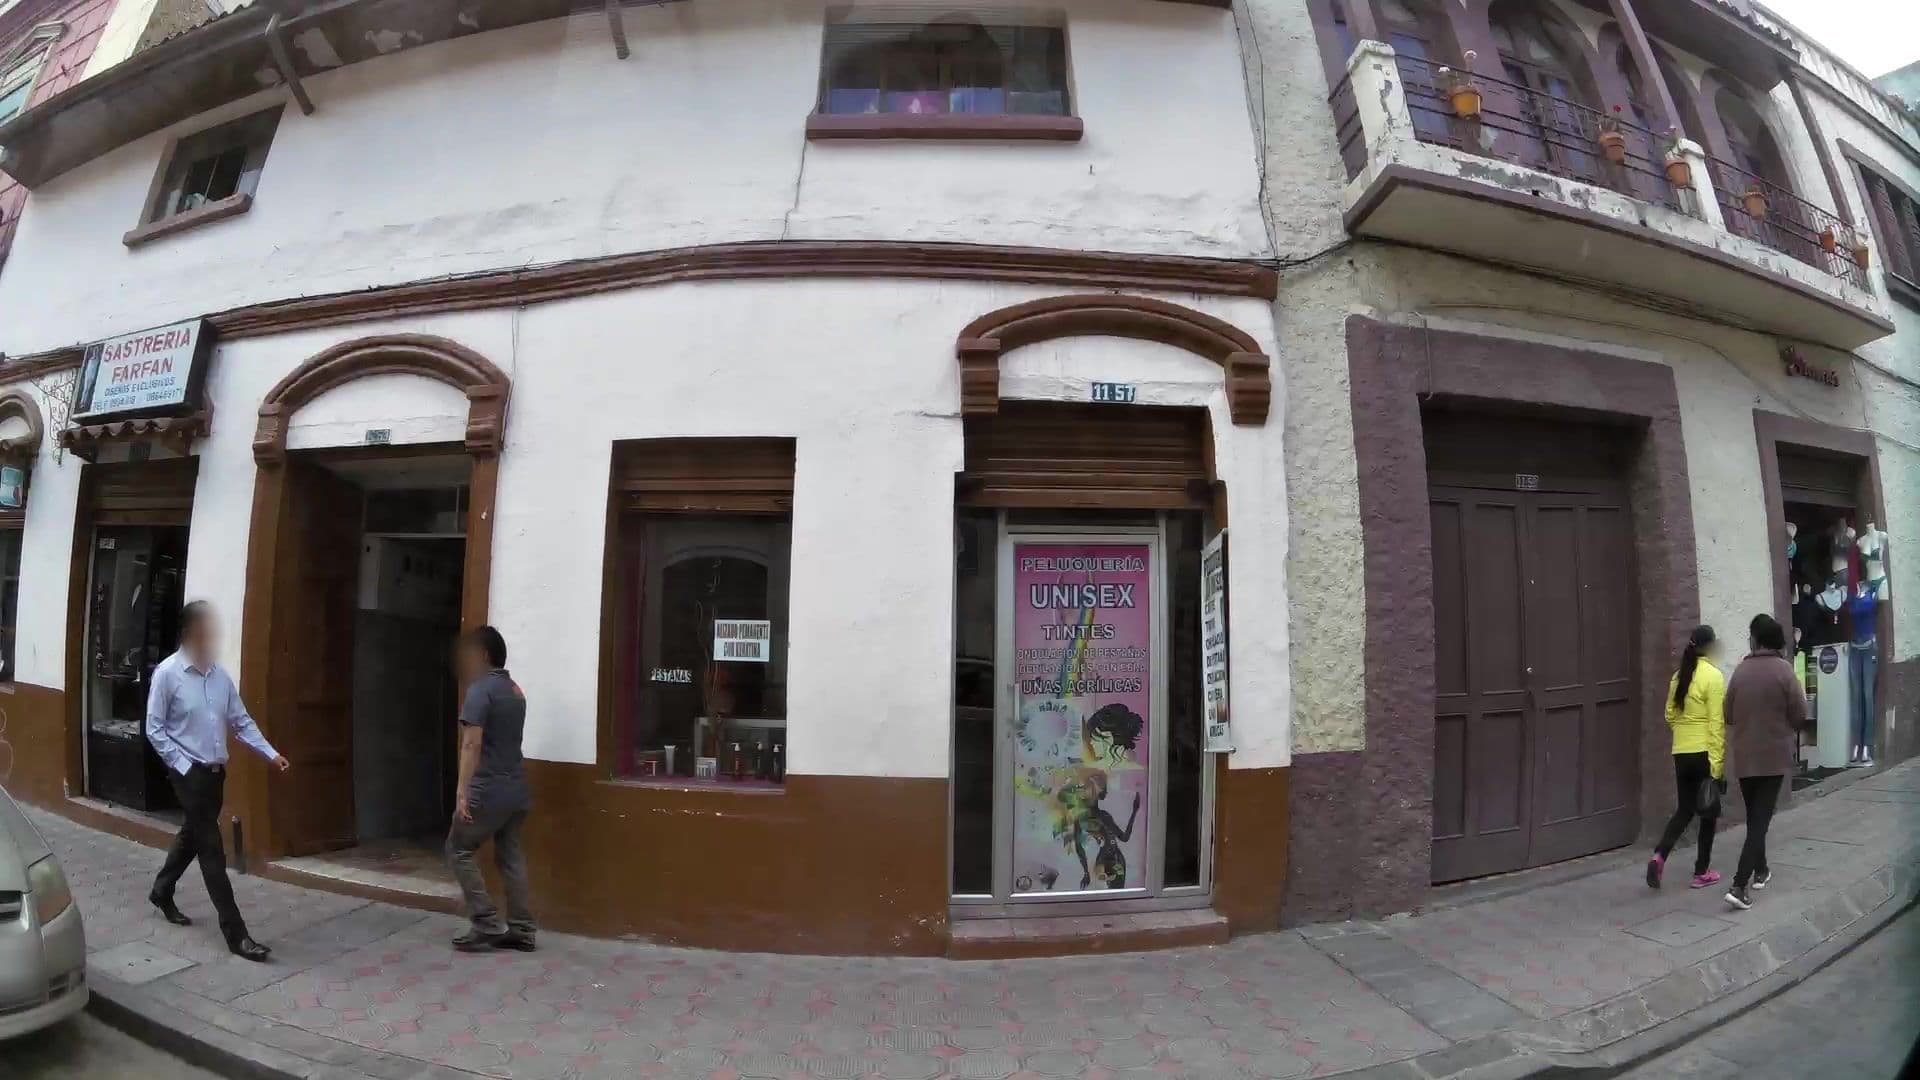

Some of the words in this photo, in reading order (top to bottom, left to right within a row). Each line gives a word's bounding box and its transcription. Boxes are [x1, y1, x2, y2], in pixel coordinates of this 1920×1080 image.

[103, 328, 191, 362] SASTRERIA
[112, 355, 174, 382] FARFAN
[1020, 555, 1145, 573] PELUQUERÍA
[1030, 583, 1136, 609] UNISEX
[1040, 623, 1117, 641] TINTES
[1022, 676, 1063, 694] UÑAS
